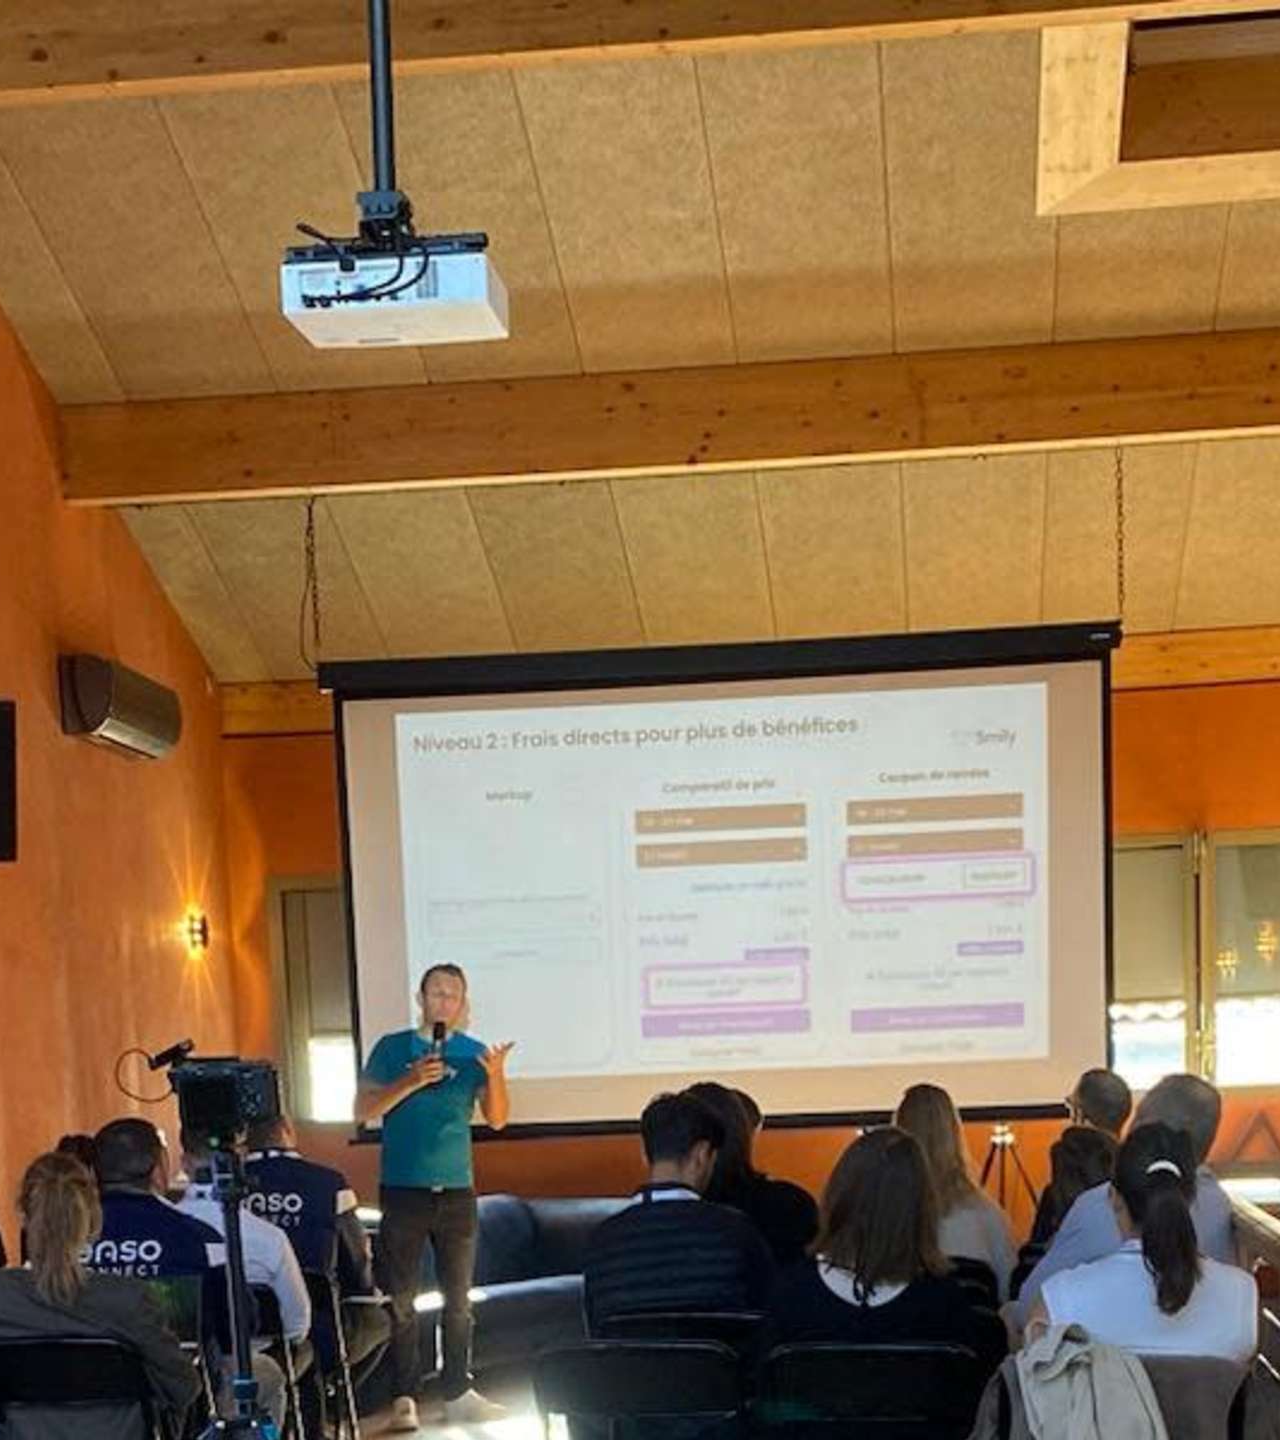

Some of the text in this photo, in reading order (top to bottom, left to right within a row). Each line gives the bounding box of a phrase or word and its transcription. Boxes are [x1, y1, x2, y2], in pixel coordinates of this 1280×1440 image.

[413, 731, 482, 752] Niveau
[486, 732, 500, 749] 2
[512, 730, 559, 749] Frais
[563, 726, 631, 747] directs
[636, 728, 685, 747] pour
[686, 722, 728, 744] plus
[732, 719, 758, 738] de
[762, 715, 859, 737] bénéfices
[976, 728, 1017, 747] Smily
